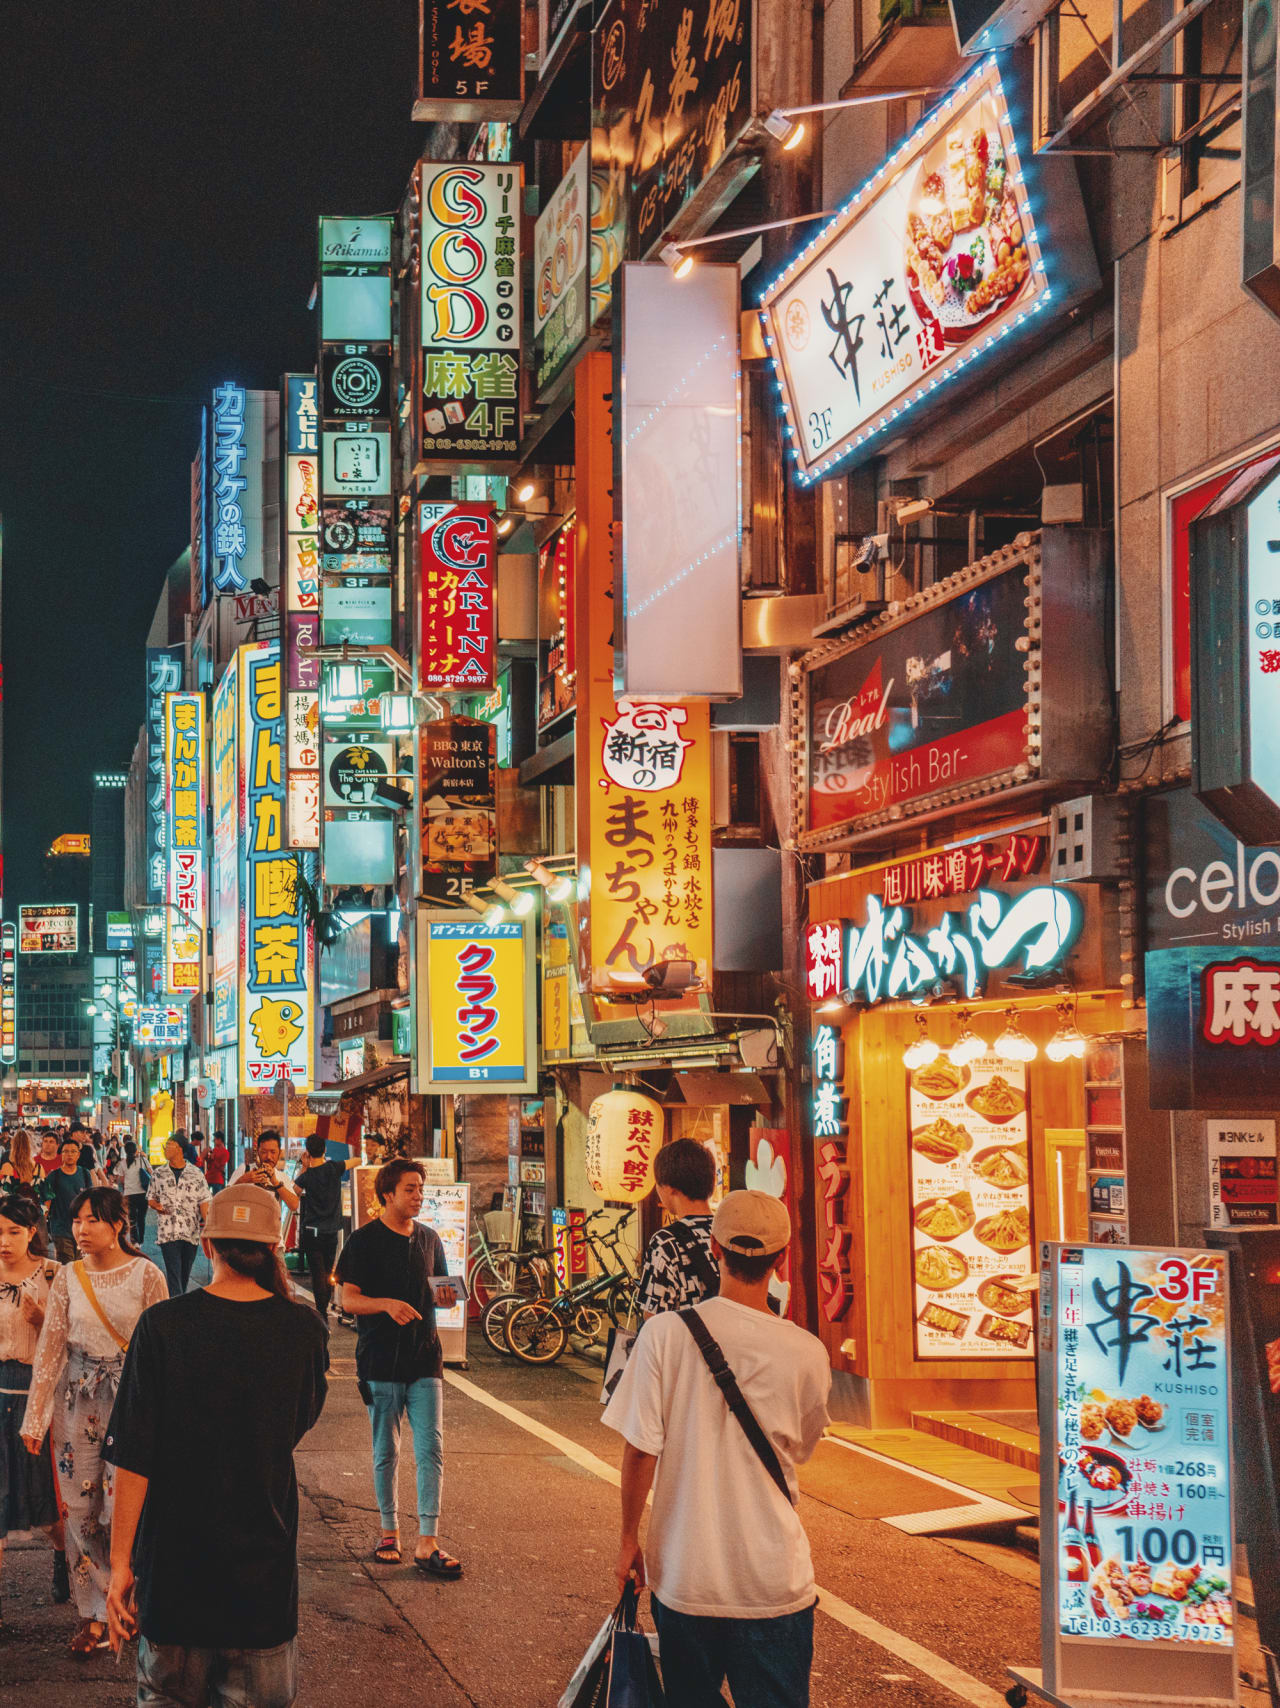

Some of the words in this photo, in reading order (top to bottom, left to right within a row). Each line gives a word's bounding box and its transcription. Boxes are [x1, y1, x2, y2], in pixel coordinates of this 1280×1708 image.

[455, 80, 490, 96] 5F
[494, 173, 516, 279] リーチ麻雀
[345, 266, 369, 277] 7F
[496, 280, 514, 342] ゴッド
[820, 267, 912, 408] 串荘
[344, 344, 369, 355] 6F
[422, 350, 519, 400] 麻雀
[870, 351, 914, 394] KUSHISO
[296, 381, 320, 450] JAビル
[345, 422, 370, 432] 5F
[465, 401, 517, 438] 4F
[807, 406, 834, 450] 3F
[213, 380, 249, 591] カラオケの鉄人
[345, 499, 369, 510] 4F
[422, 505, 445, 521] 3F
[345, 577, 370, 588] 3F
[431, 515, 489, 677] CARINA
[439, 570, 461, 674] カリーナ
[427, 674, 488, 684] 080-8720-9897
[820, 677, 895, 753] Real
[347, 733, 370, 743] 1F
[433, 740, 458, 752] BBQ
[460, 740, 484, 752] 東京
[607, 728, 682, 771] 新宿
[301, 752, 317, 765] 1F
[431, 755, 487, 769] Walton's
[172, 702, 199, 848] まんが喫茶
[338, 773, 355, 783] The
[631, 769, 657, 788] の
[347, 811, 371, 821] B1
[682, 797, 702, 873] 博多もつ鍋
[659, 799, 681, 927] 九州のうまかもん
[882, 834, 1042, 907] 旭川味噌ラーメン
[445, 877, 475, 897] 2F
[604, 795, 661, 973] まっちゃん
[682, 875, 704, 930] 水炊き
[431, 922, 521, 937] オンラインカフェ
[1221, 917, 1272, 940] Stylish
[454, 942, 502, 1063] クラウン
[140, 1012, 168, 1026] 完全
[152, 1025, 181, 1038] 個室
[247, 1061, 306, 1080] マンボー
[469, 1068, 489, 1079] B1
[812, 1024, 842, 1137] 角煮
[618, 1107, 656, 1193] 鉄なべ餃子
[1157, 1258, 1217, 1303] 3F
[1062, 1270, 1083, 1326] 三十年
[1085, 1260, 1219, 1386] 串荘
[1153, 1381, 1219, 1397] KUSHISO
[1061, 1327, 1081, 1491] 継ぎ足された秘伝のタレ
[1184, 1411, 1216, 1427] 個室
[1184, 1426, 1216, 1442] 完備
[1129, 1480, 1171, 1498] 串焼き
[1127, 1501, 1186, 1523] 串揚げ
